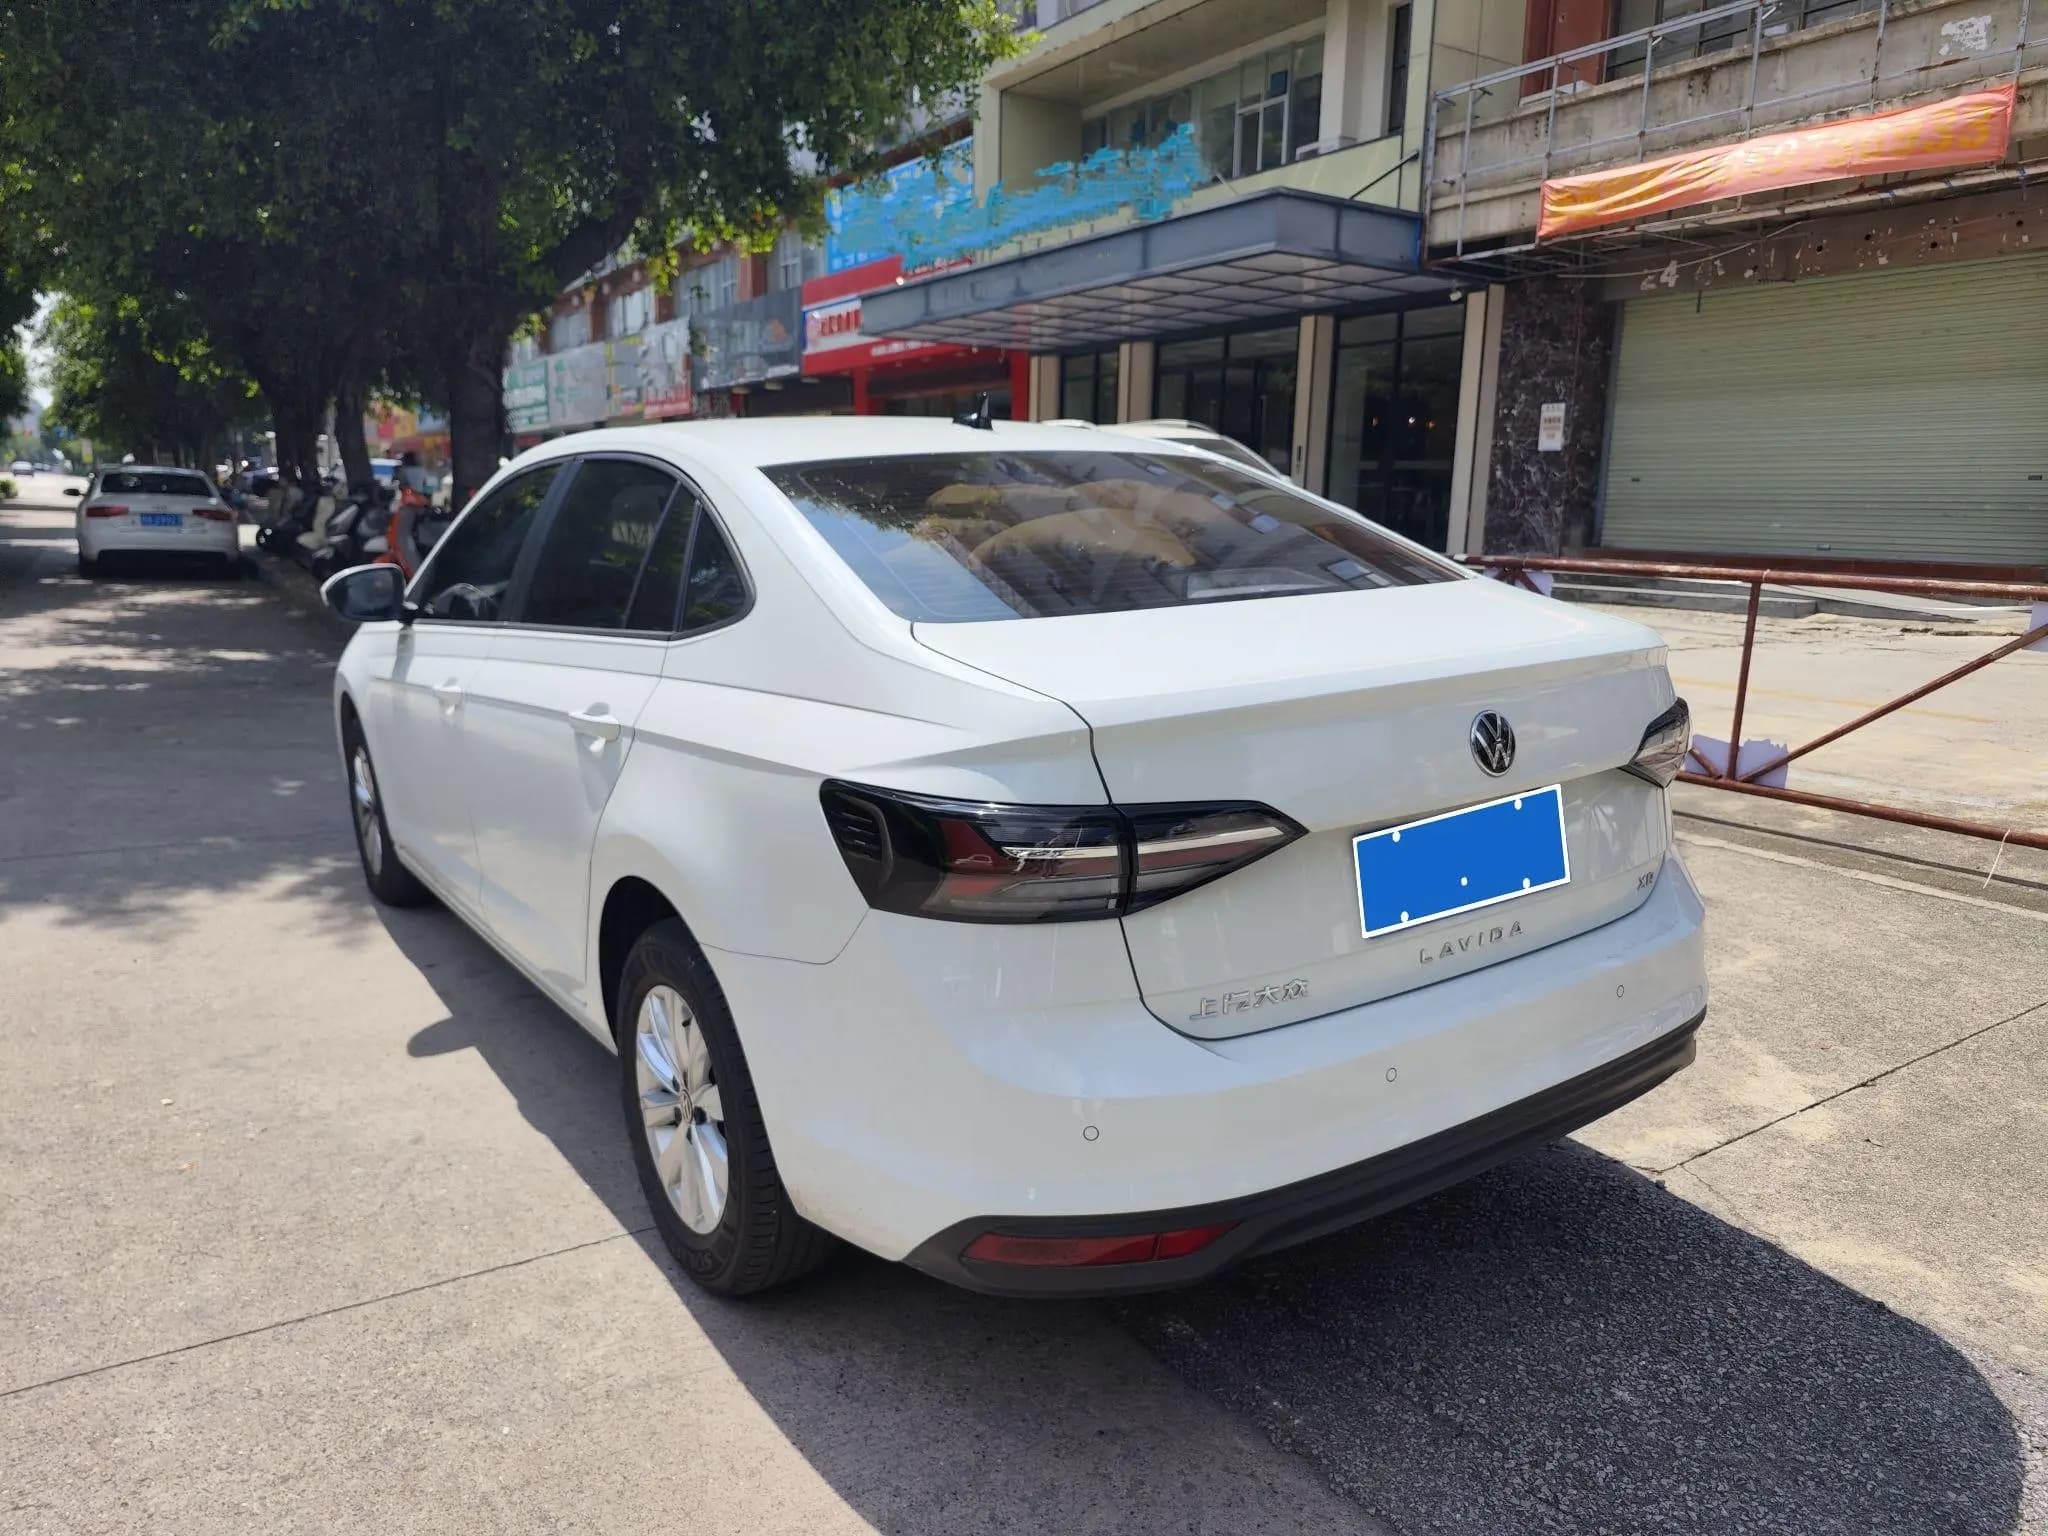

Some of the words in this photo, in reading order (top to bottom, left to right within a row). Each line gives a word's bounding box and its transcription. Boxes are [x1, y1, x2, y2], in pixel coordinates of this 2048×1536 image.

[1419, 920, 1524, 964] LAVIDA
[1189, 977, 1310, 1020] 上汽大众
